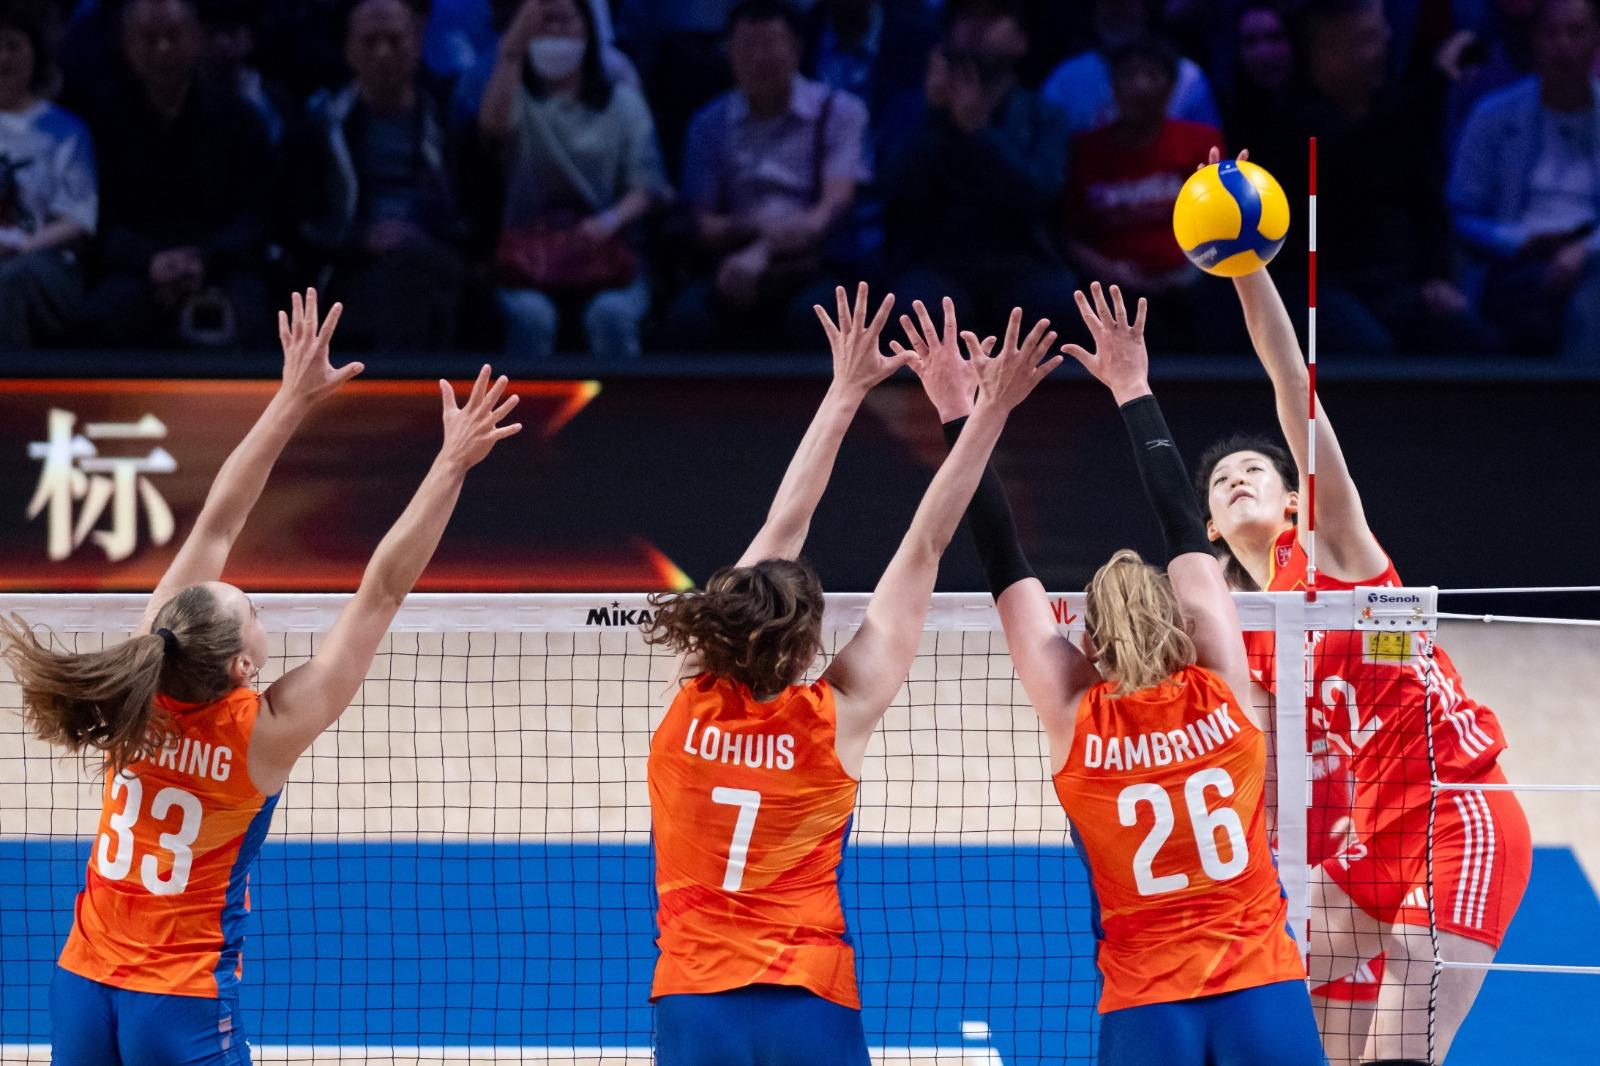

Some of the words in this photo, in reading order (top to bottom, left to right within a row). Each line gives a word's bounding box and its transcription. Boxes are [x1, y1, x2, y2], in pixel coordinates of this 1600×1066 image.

[26, 407, 178, 561] 标
[586, 600, 655, 627] MIKA
[1379, 595, 1420, 603] Senoh
[150, 732, 233, 782] RING
[684, 718, 795, 770] LOHUIS
[1084, 702, 1241, 771] DAMBRINK
[97, 768, 203, 896] 33
[712, 786, 761, 892] 7
[1117, 767, 1249, 896] 26
